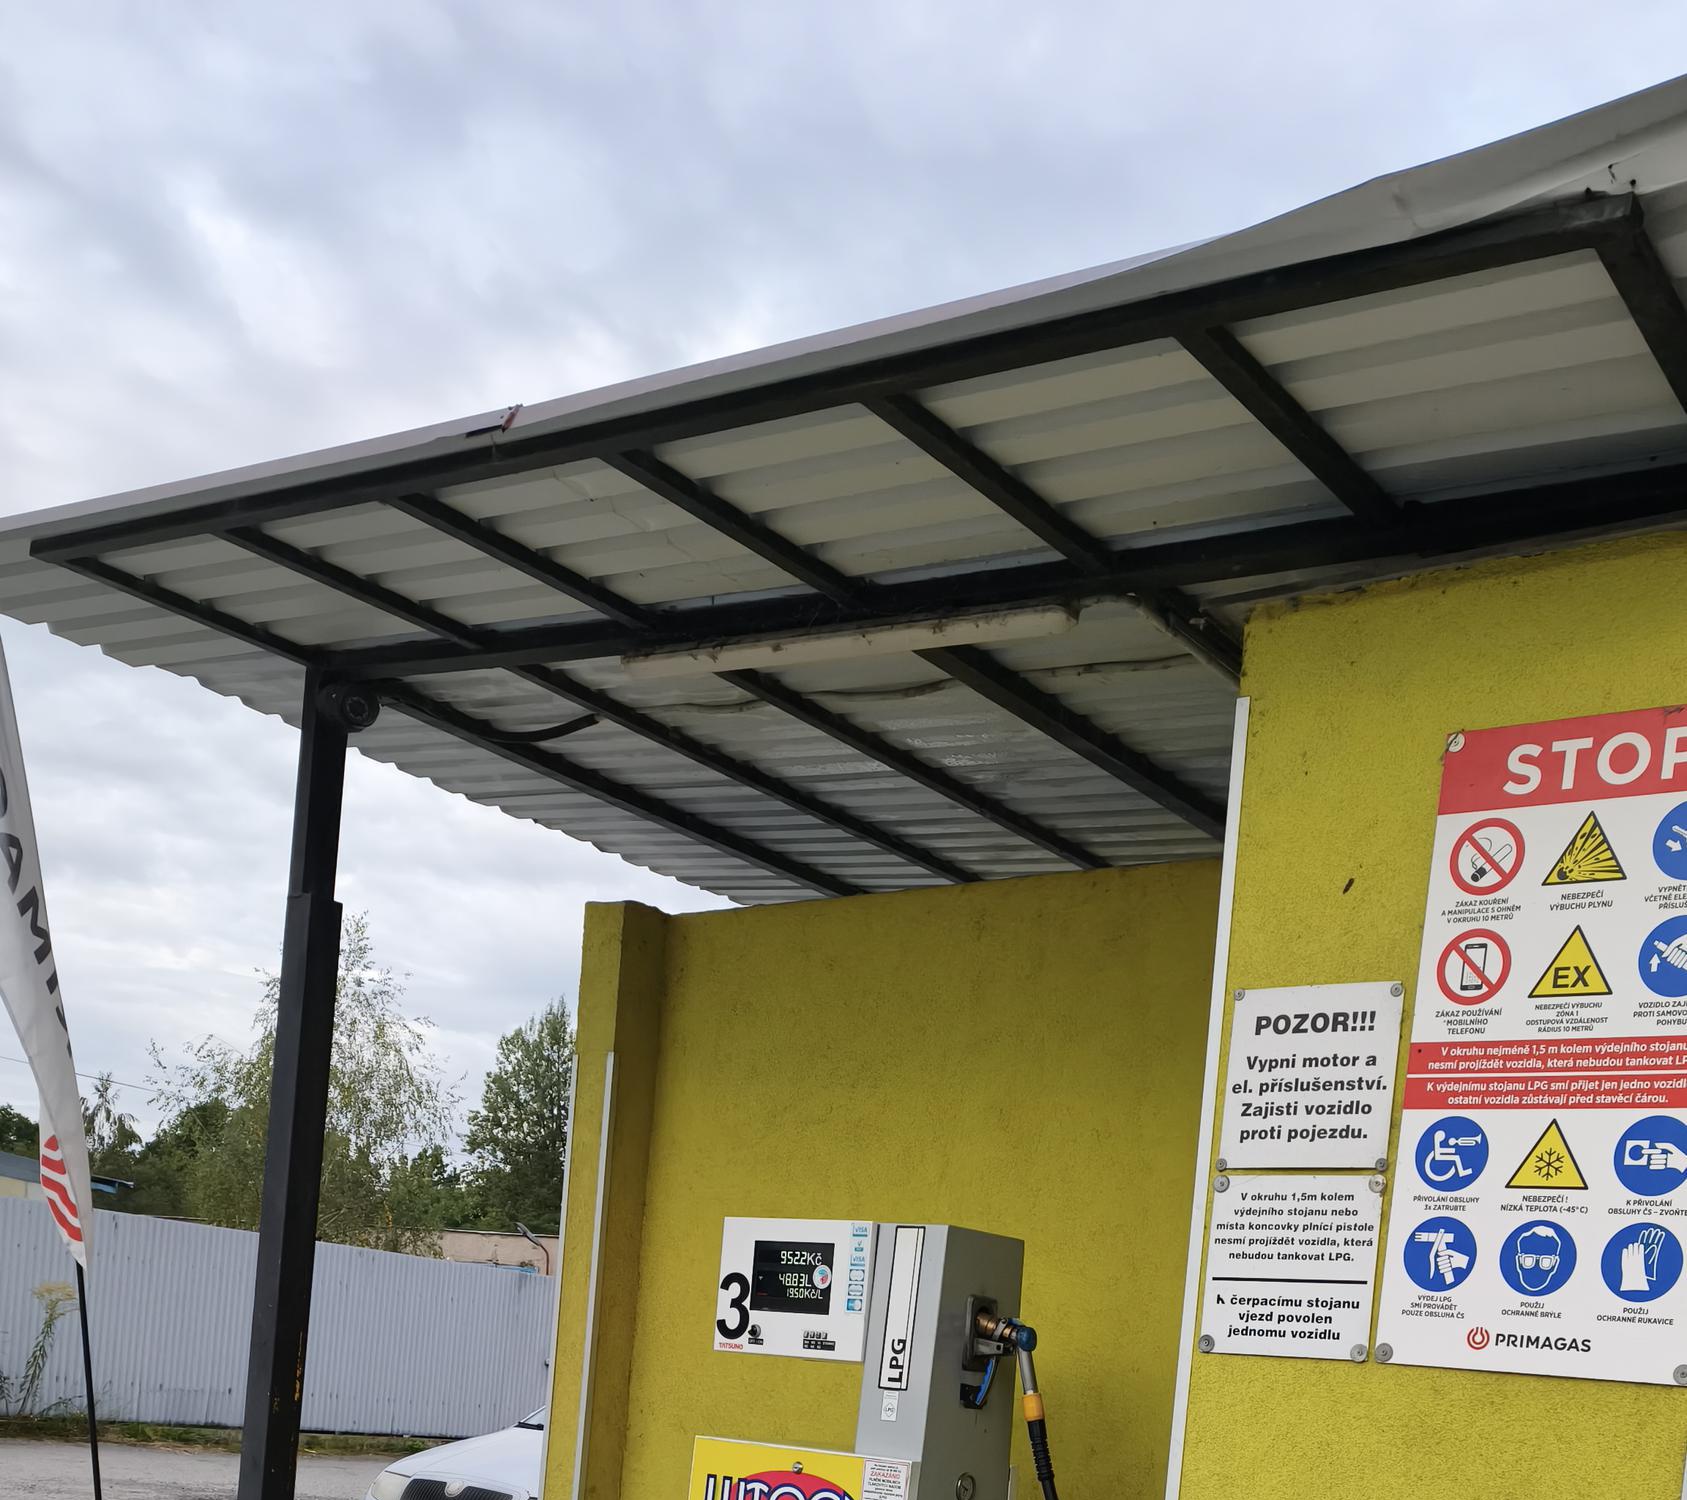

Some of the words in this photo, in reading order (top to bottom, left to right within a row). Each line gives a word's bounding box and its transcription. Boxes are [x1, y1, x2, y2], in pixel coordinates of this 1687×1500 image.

[1561, 890, 1604, 900] NEBEZPEČÍ
[1455, 899, 1477, 908] ZÁKAZ
[1479, 897, 1509, 906] KOUŘENÍ
[1550, 901, 1587, 911] VÝBUCHU
[1588, 900, 1613, 909] PLYNU
[1448, 907, 1489, 916] MANIPULACE
[1453, 915, 1480, 923] OKRUHU
[1491, 913, 1514, 921] METRŮ
[1552, 965, 1592, 989] EX
[1534, 1002, 1570, 1010] NEBEZPEČÍ
[1571, 1001, 1603, 1009] VÝBUCHU
[1435, 1009, 1460, 1018] ZÁKAZ
[1461, 1007, 1503, 1017] POUŽÍVÁNÍ
[1633, 1010, 1655, 1018] PROTI
[1254, 1010, 1377, 1036] POZOR!!!
[1446, 1017, 1488, 1026] MOBILNÍHO
[1525, 1018, 1564, 1026] ODSTUPOVÁ
[1566, 1016, 1609, 1024] VZDÁLENOST
[1448, 1027, 1485, 1035] TELEFONU
[1538, 1025, 1562, 1033] RÁDIUS
[1571, 1024, 1594, 1032] METRŮ
[1441, 1046, 1449, 1056] V
[1450, 1045, 1485, 1056] okruhu
[1486, 1044, 1530, 1056] nejméně
[1531, 1045, 1546, 1056] 1,5
[1548, 1046, 1558, 1054] m
[1560, 1043, 1592, 1054] kolem
[1595, 1042, 1647, 1055] výdejního
[1246, 1053, 1297, 1073] Vypni
[1302, 1053, 1360, 1068] motor
[1365, 1055, 1377, 1067] a
[1428, 1060, 1457, 1070] nesmí
[1458, 1059, 1503, 1071] projíždět
[1506, 1058, 1545, 1070] vozidla,
[1547, 1058, 1574, 1068] která
[1576, 1057, 1623, 1067] nebudou
[1625, 1055, 1674, 1066] tankovat
[1231, 1079, 1253, 1094] el.
[1258, 1075, 1388, 1096] příslušenství.
[1427, 1082, 1434, 1091] K
[1436, 1081, 1487, 1092] výdejnímu
[1489, 1081, 1525, 1092] stojanu
[1527, 1081, 1548, 1090] LPG
[1550, 1080, 1569, 1090] smí
[1570, 1079, 1599, 1091] přijet
[1601, 1080, 1618, 1091] jen
[1619, 1079, 1651, 1091] jedno
[1447, 1095, 1482, 1105] ostatní
[1484, 1094, 1520, 1105] vozidla
[1521, 1093, 1567, 1106] zůstávají
[1568, 1093, 1595, 1105] před
[1595, 1092, 1633, 1103] stavěcí
[1635, 1092, 1669, 1103] čárou.
[1240, 1101, 1299, 1119] Zajisti
[1304, 1100, 1373, 1116] vozidlo
[1239, 1125, 1283, 1143] proti
[1287, 1124, 1368, 1142] pojezdu.
[1240, 1192, 1248, 1201] V
[1250, 1192, 1288, 1201] okruhu
[1291, 1192, 1317, 1203] 1,5m
[1320, 1192, 1355, 1201] kolem
[1413, 1194, 1448, 1203] PŘIVOLÁNÍ
[1522, 1194, 1564, 1203] NEBEZPEČÍ
[1632, 1198, 1673, 1207] PŘIVOLÁNÍ
[1233, 1207, 1284, 1217] výdejního
[1287, 1207, 1328, 1218] stojanu
[1331, 1207, 1359, 1217] nebo
[1433, 1204, 1467, 1212] ZATRUBTE
[1500, 1203, 1523, 1212] NÍZKÁ
[1525, 1204, 1557, 1213] TEPLOTA
[1607, 1207, 1641, 1215] OBSLUHY
[1642, 1207, 1652, 1216] ČS
[1216, 1221, 1245, 1231] místa
[1248, 1221, 1300, 1233] koncovky
[1302, 1221, 1333, 1233] plnící
[1335, 1222, 1375, 1233] pistole
[1214, 1236, 1246, 1246] nesmí
[1248, 1236, 1295, 1248] projíždět
[1298, 1237, 1340, 1248] vozidla,
[1343, 1237, 1374, 1247] která
[1228, 1251, 1274, 1261] nebudou
[1277, 1252, 1325, 1262] tankovat
[1328, 1252, 1355, 1262] LPG.
[716, 1271, 751, 1340] 3
[1230, 1294, 1302, 1309] čerpacímu
[1306, 1297, 1360, 1311] stojanu
[1410, 1301, 1422, 1309] SMÍ
[1520, 1301, 1545, 1309] POUŽIJ
[1424, 1311, 1455, 1319] OBSLUHA
[1456, 1311, 1465, 1319] ČS
[1501, 1309, 1539, 1318] OCHRANNÉ
[1623, 1307, 1649, 1315] POUŽIJ
[1238, 1311, 1274, 1324] vjezd
[1277, 1312, 1333, 1325] povolen
[1637, 1316, 1674, 1326] RUKAVICE
[1227, 1324, 1287, 1338] jednomu
[1290, 1327, 1341, 1341] vozidlu
[1495, 1333, 1592, 1353] PRIMAGAS
[887, 1338, 907, 1383] LPG
